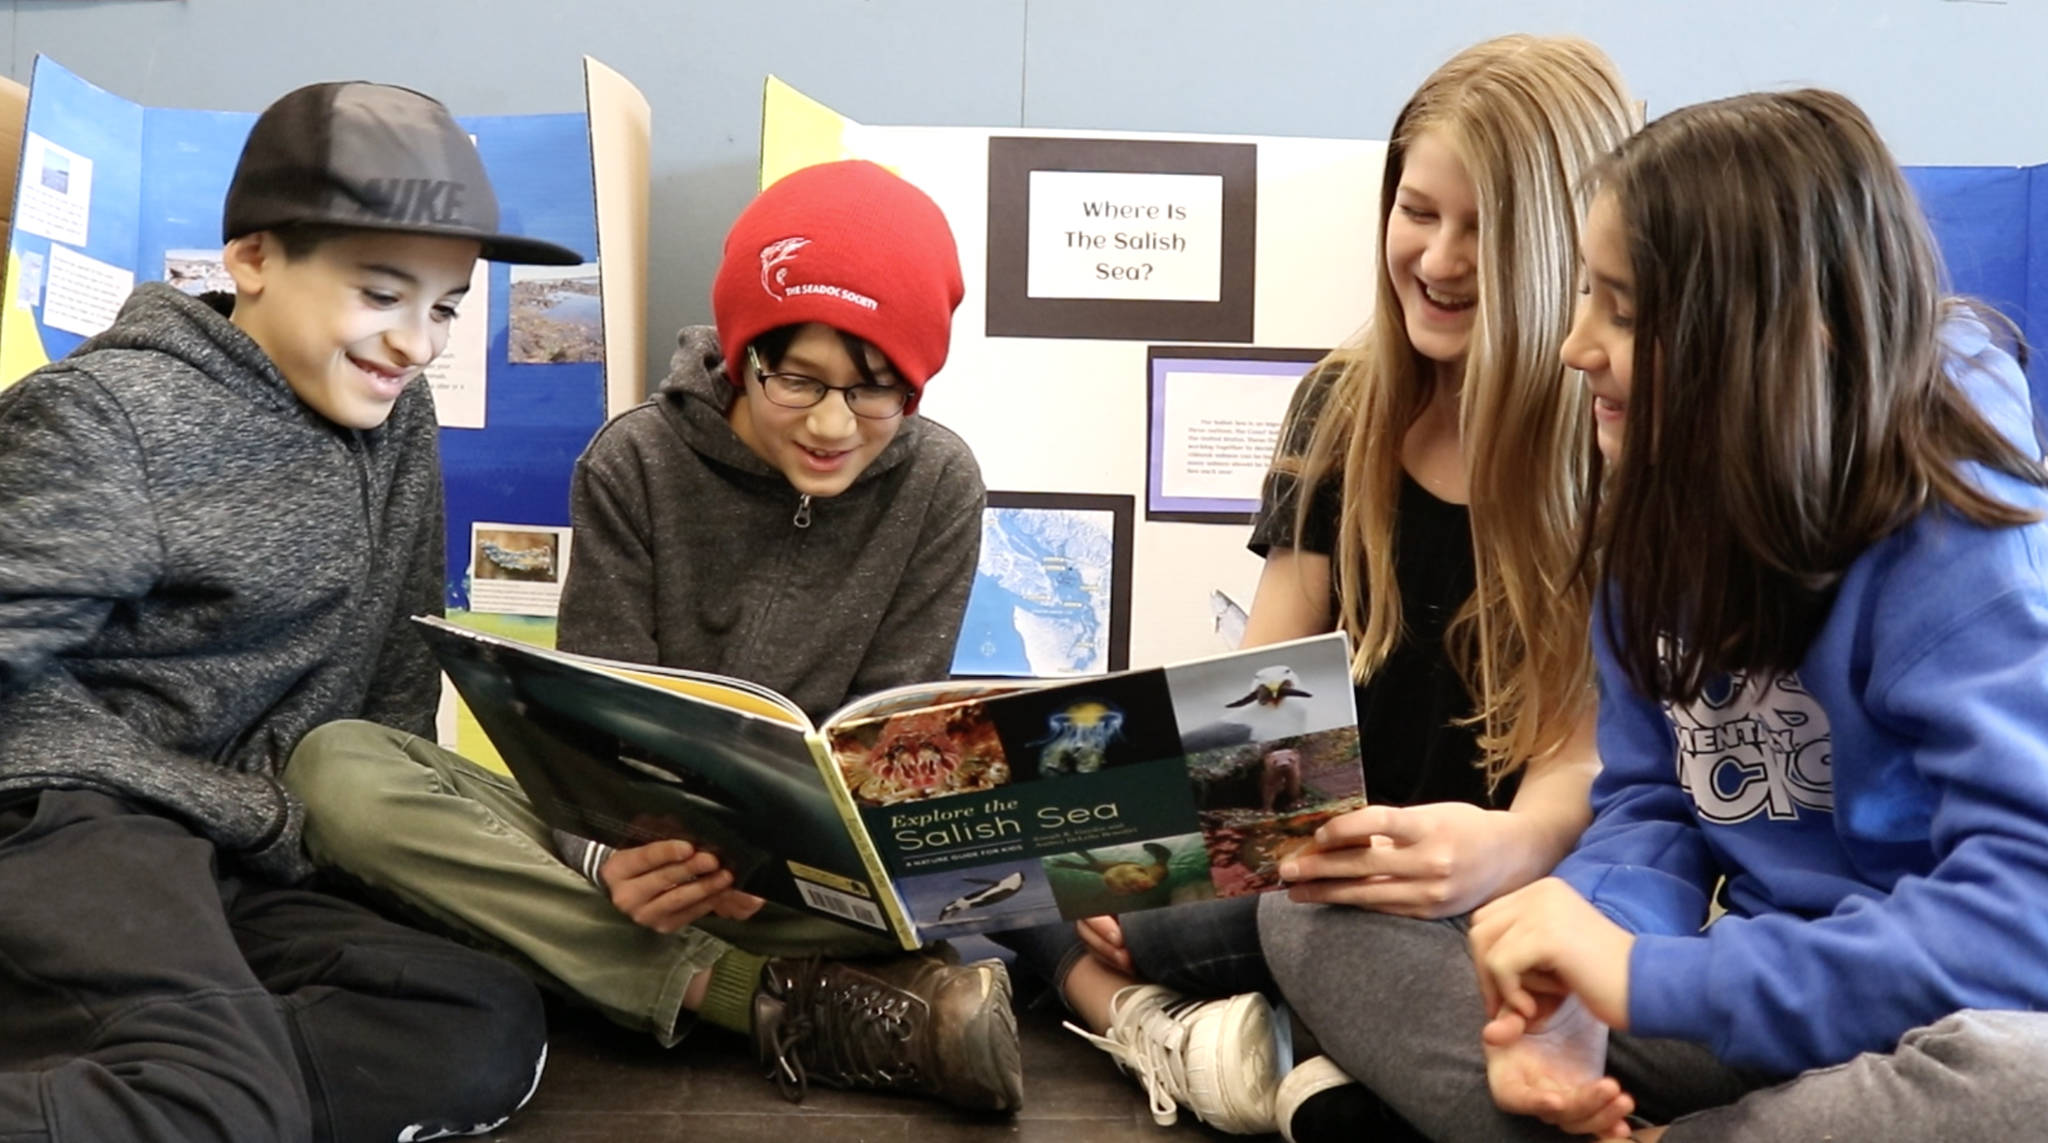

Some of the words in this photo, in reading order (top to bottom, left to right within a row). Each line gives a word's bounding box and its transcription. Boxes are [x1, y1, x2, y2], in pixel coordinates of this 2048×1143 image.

[363, 178, 466, 224] NIKE
[1083, 201, 1160, 219] Where
[1167, 203, 1187, 220] Is
[1064, 231, 1106, 250] The
[1114, 232, 1186, 252] Salish
[1096, 263, 1153, 280] Sea?
[785, 285, 802, 296] THE
[841, 289, 878, 311] SOCIETY
[891, 807, 975, 829] Explore
[984, 799, 1018, 813] the
[895, 817, 1021, 851] Salish
[1037, 803, 1119, 829] Sea
[913, 856, 949, 866] NATURE
[950, 851, 978, 860] GUIDE
[980, 847, 999, 855] FOR
[1001, 844, 1023, 853] KIDS
